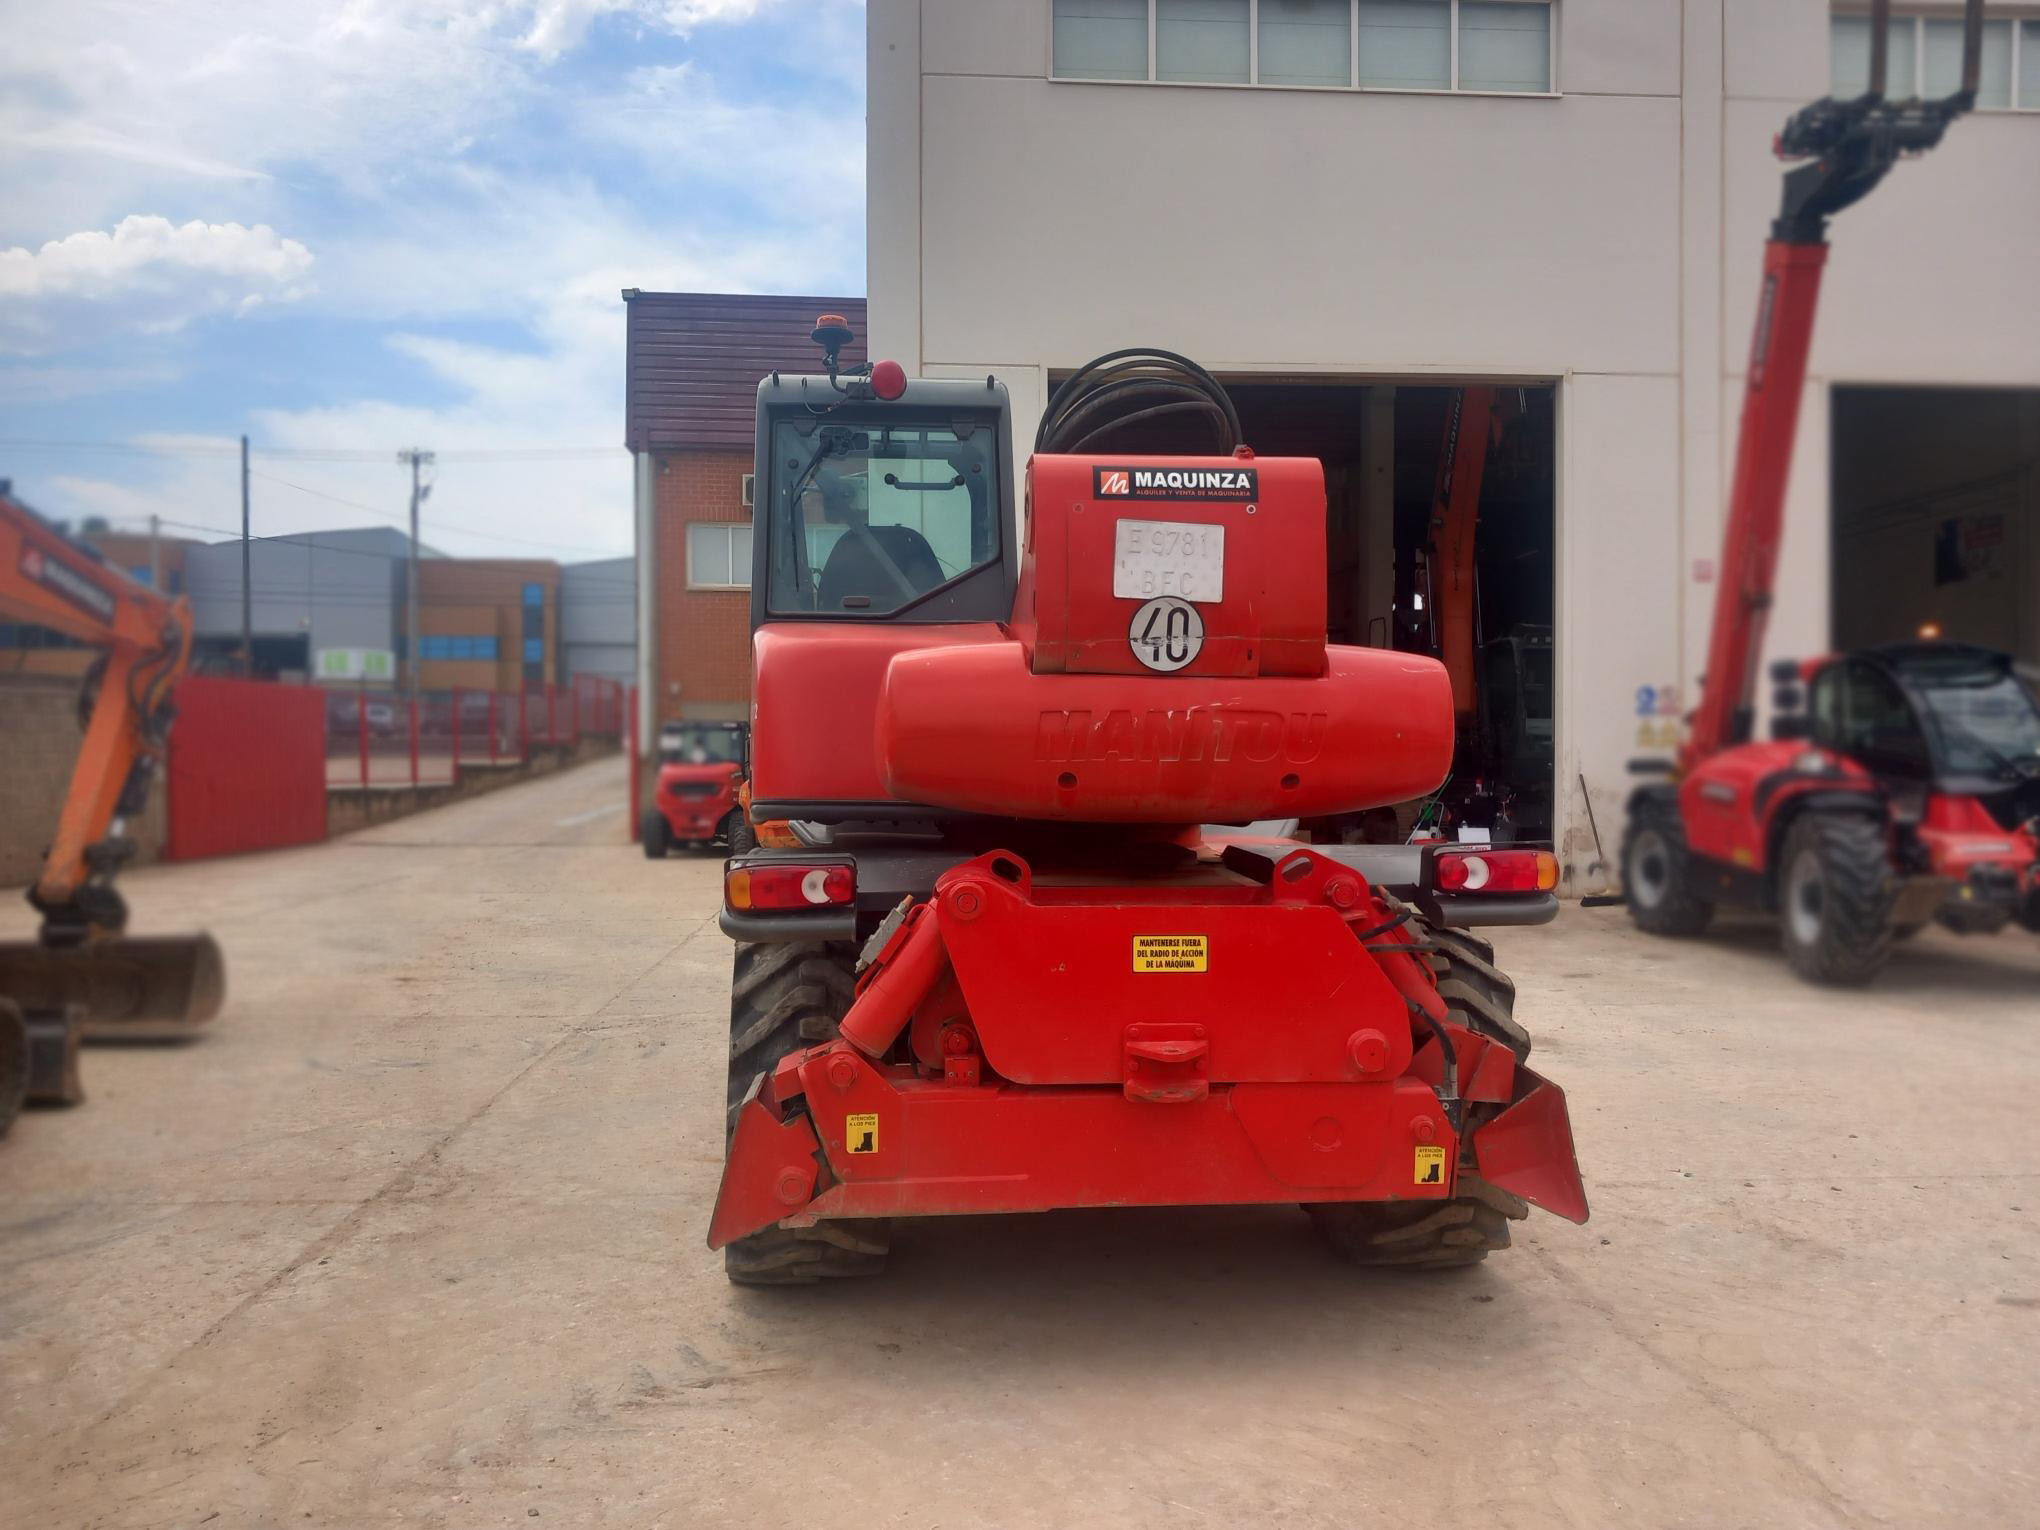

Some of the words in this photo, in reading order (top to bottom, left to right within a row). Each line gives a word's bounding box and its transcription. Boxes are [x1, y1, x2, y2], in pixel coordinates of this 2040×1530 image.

[1135, 472, 1251, 489] MAQUINZA
[1141, 606, 1190, 663] 40
[1034, 708, 1328, 765] MANITOU
[1139, 939, 1179, 947] MANTENERSE
[1182, 939, 1201, 947] FUERA
[1137, 949, 1149, 958] DEL
[1150, 949, 1170, 958] RADIO
[1171, 949, 1180, 958] DE
[1181, 947, 1204, 958] ACCIÓN
[1146, 960, 1154, 969] DE
[1155, 960, 1164, 969] LA
